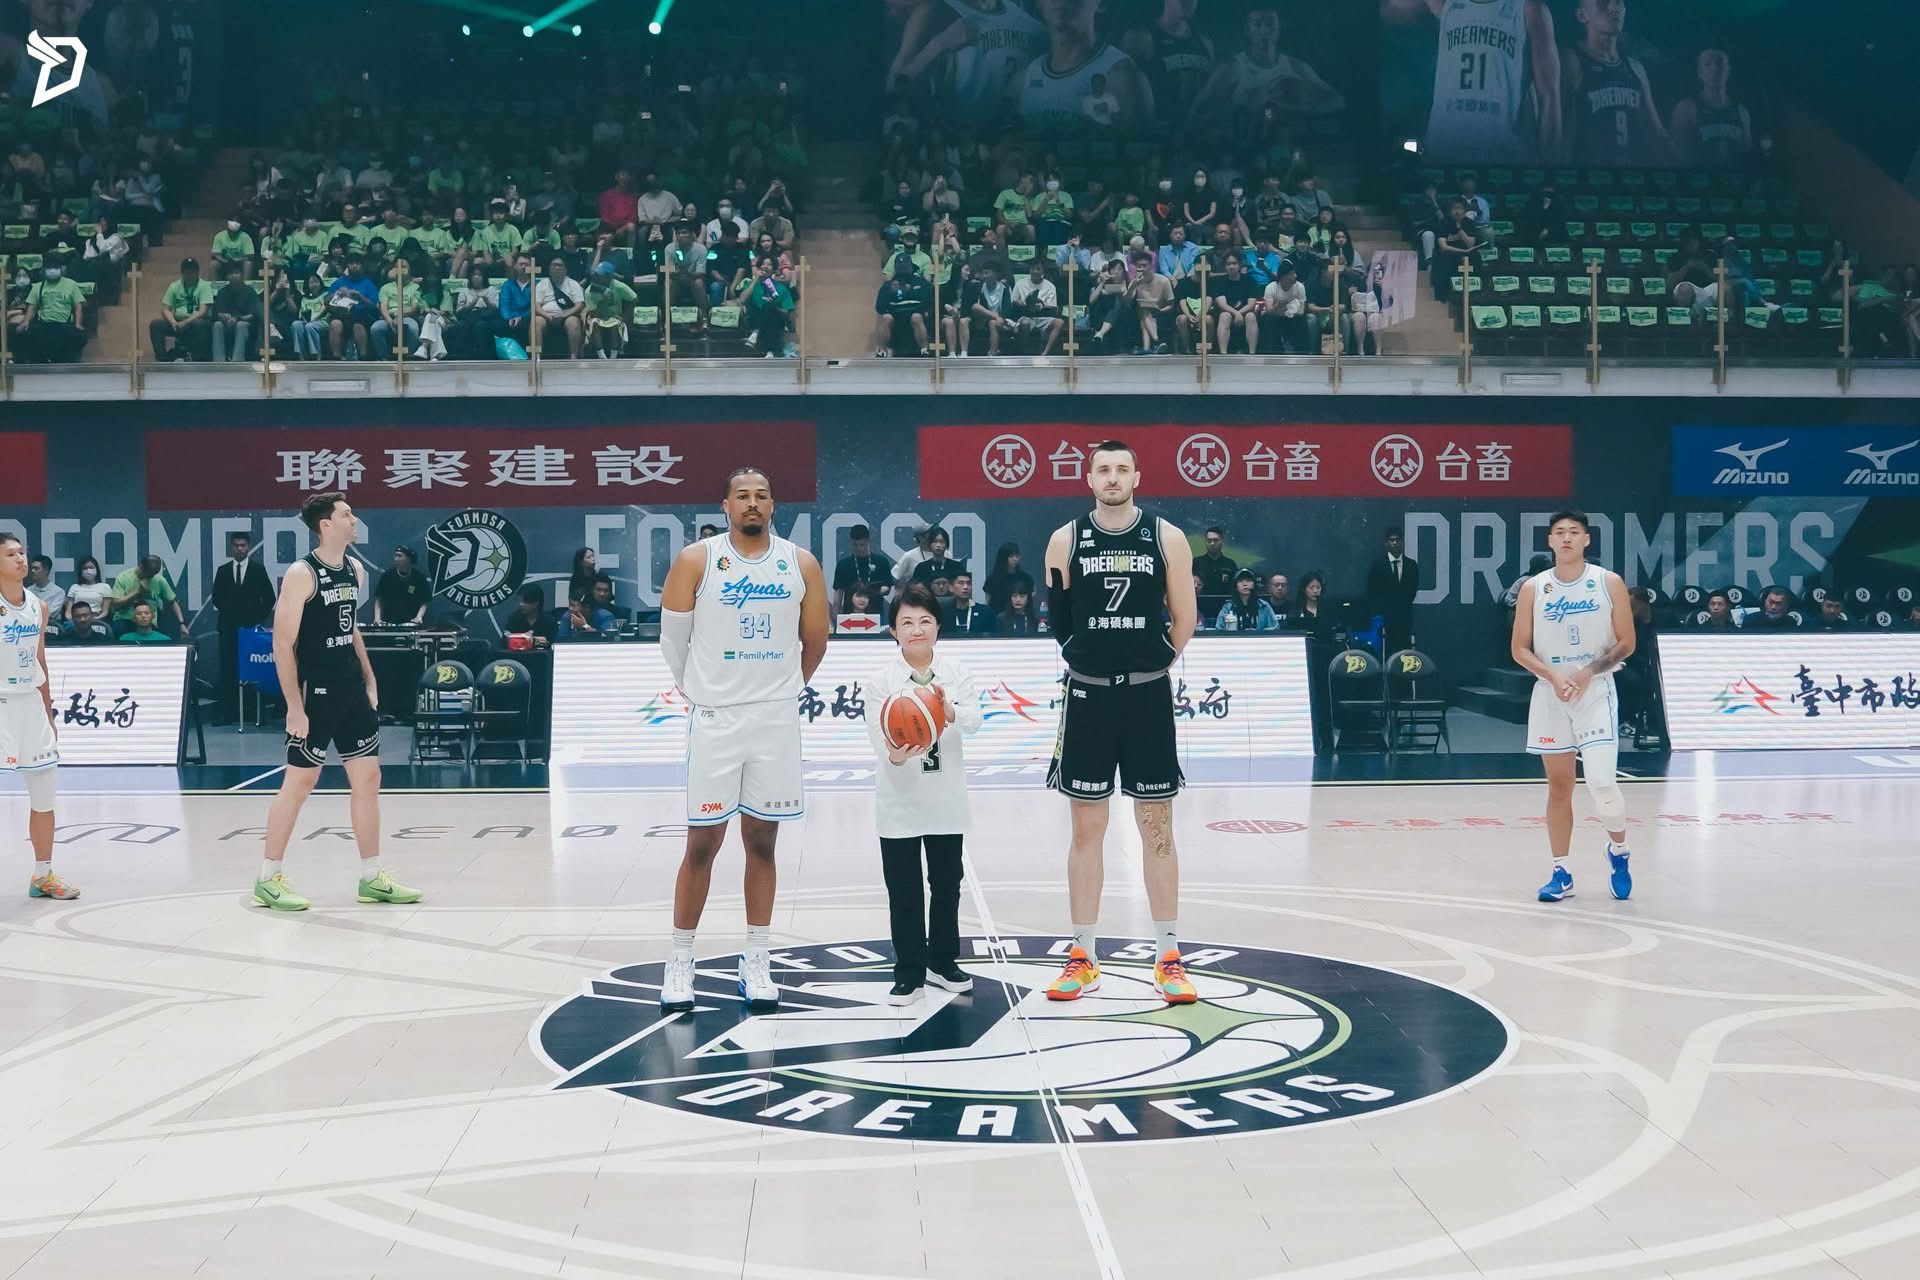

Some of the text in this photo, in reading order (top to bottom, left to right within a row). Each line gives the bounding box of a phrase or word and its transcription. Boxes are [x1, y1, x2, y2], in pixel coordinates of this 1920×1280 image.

[1446, 25, 1517, 60] DREAMERS
[1460, 52, 1487, 90] 21
[275, 443, 684, 490] 聯聚建設
[987, 457, 1031, 481] HAM
[1182, 456, 1225, 480] HAM
[1242, 440, 1320, 481] 台畜
[1376, 457, 1419, 481] HAM
[1435, 441, 1512, 481] 台畜
[447, 512, 506, 531] FORMOSA
[446, 584, 512, 607] DREAMERS
[719, 575, 791, 609] Aquas
[1104, 577, 1130, 611] 7
[339, 604, 352, 632] 5
[1544, 596, 1600, 623] Aquas
[740, 613, 771, 639] 34
[250, 652, 273, 663] mol
[738, 651, 784, 661] FamilyMart
[701, 802, 723, 813] SYM
[769, 938, 1239, 969] FOMOSA
[677, 1074, 1395, 1136] DREAMERS
